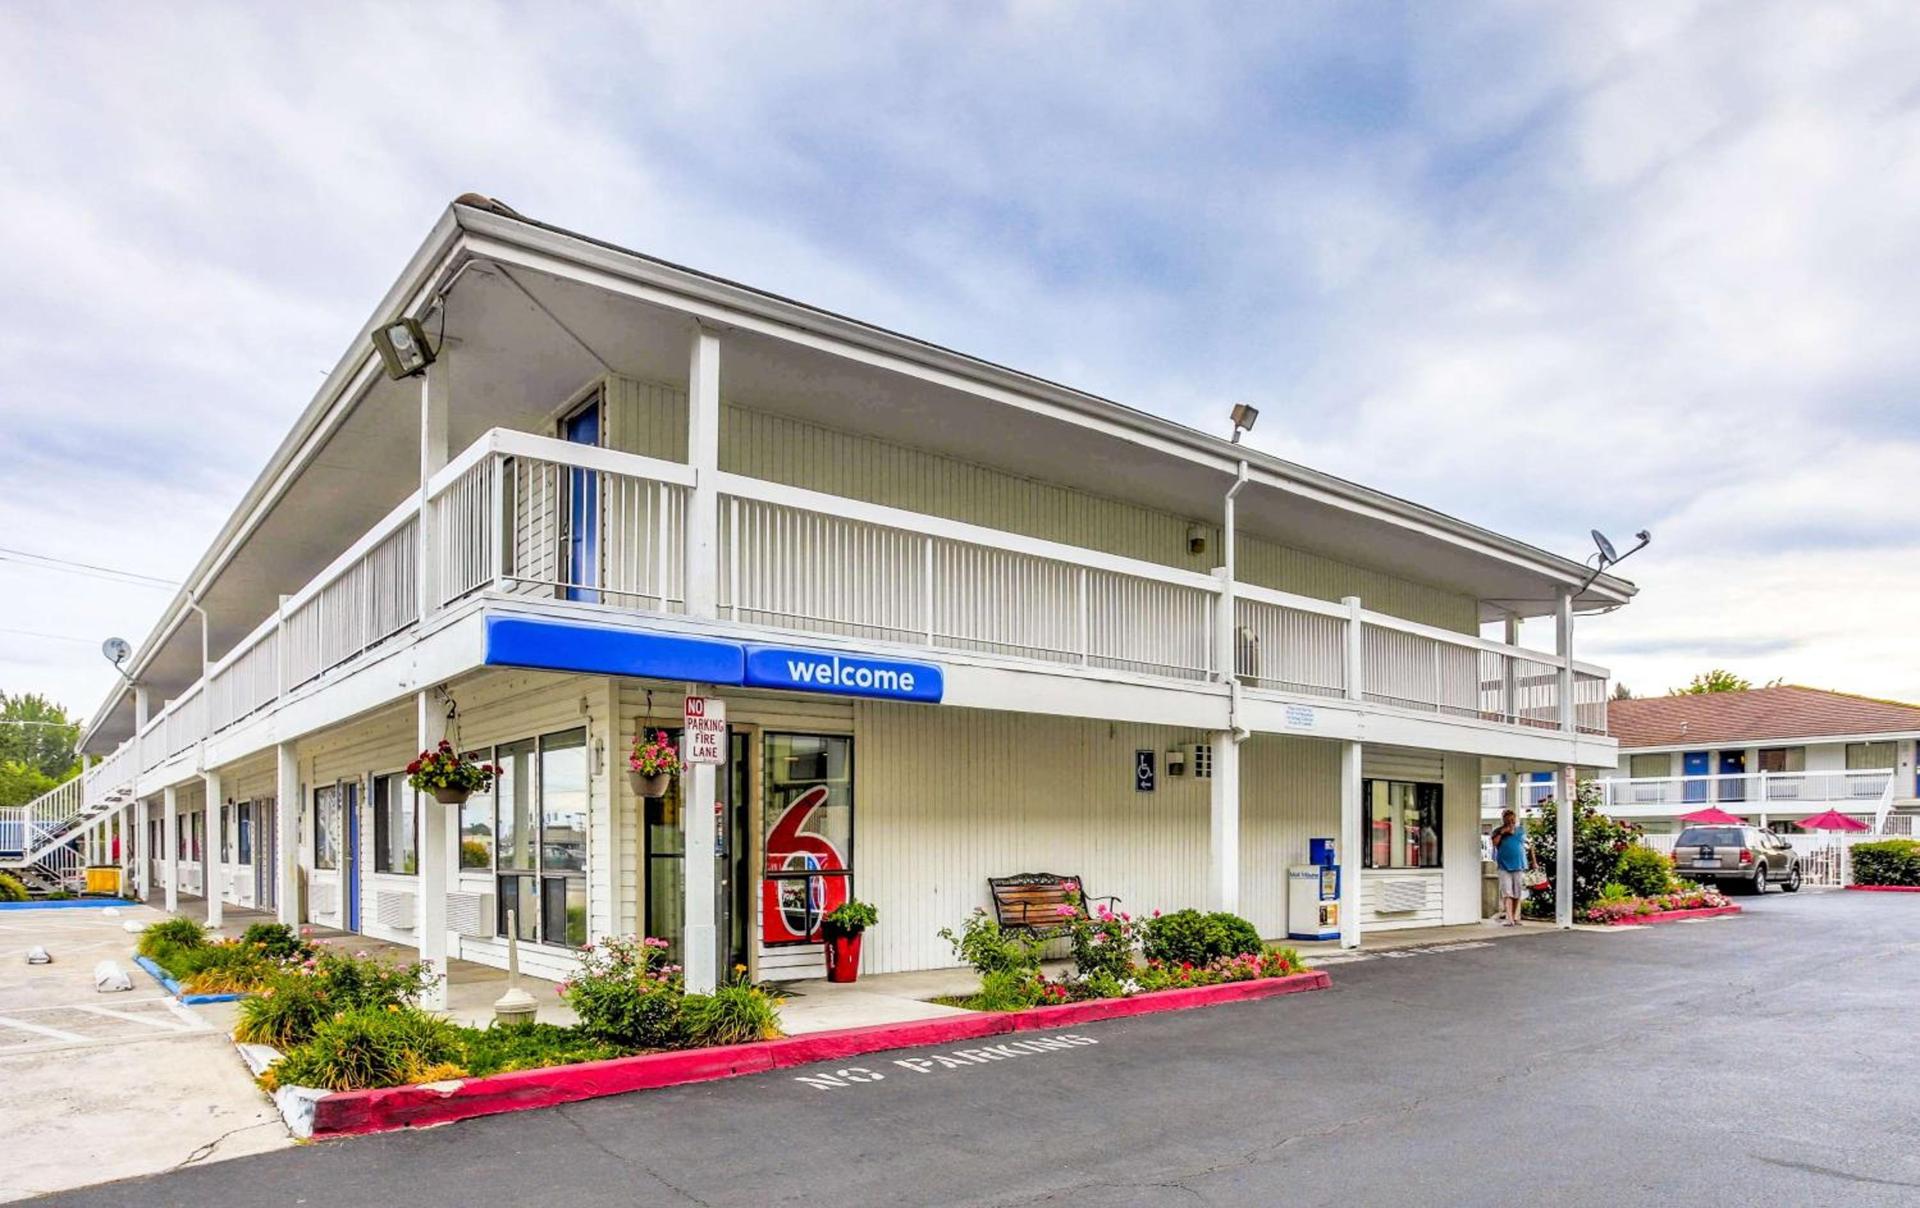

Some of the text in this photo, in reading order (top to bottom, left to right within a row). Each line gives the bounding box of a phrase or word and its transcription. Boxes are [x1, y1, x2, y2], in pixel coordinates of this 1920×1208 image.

[787, 656, 915, 692] welcome
[687, 698, 703, 715] NO
[687, 717, 724, 733] PARKING
[695, 733, 716, 745] FIRE
[693, 745, 718, 758] LANE
[763, 785, 850, 942] 6
[794, 1034, 1099, 1090] NO PARKING
